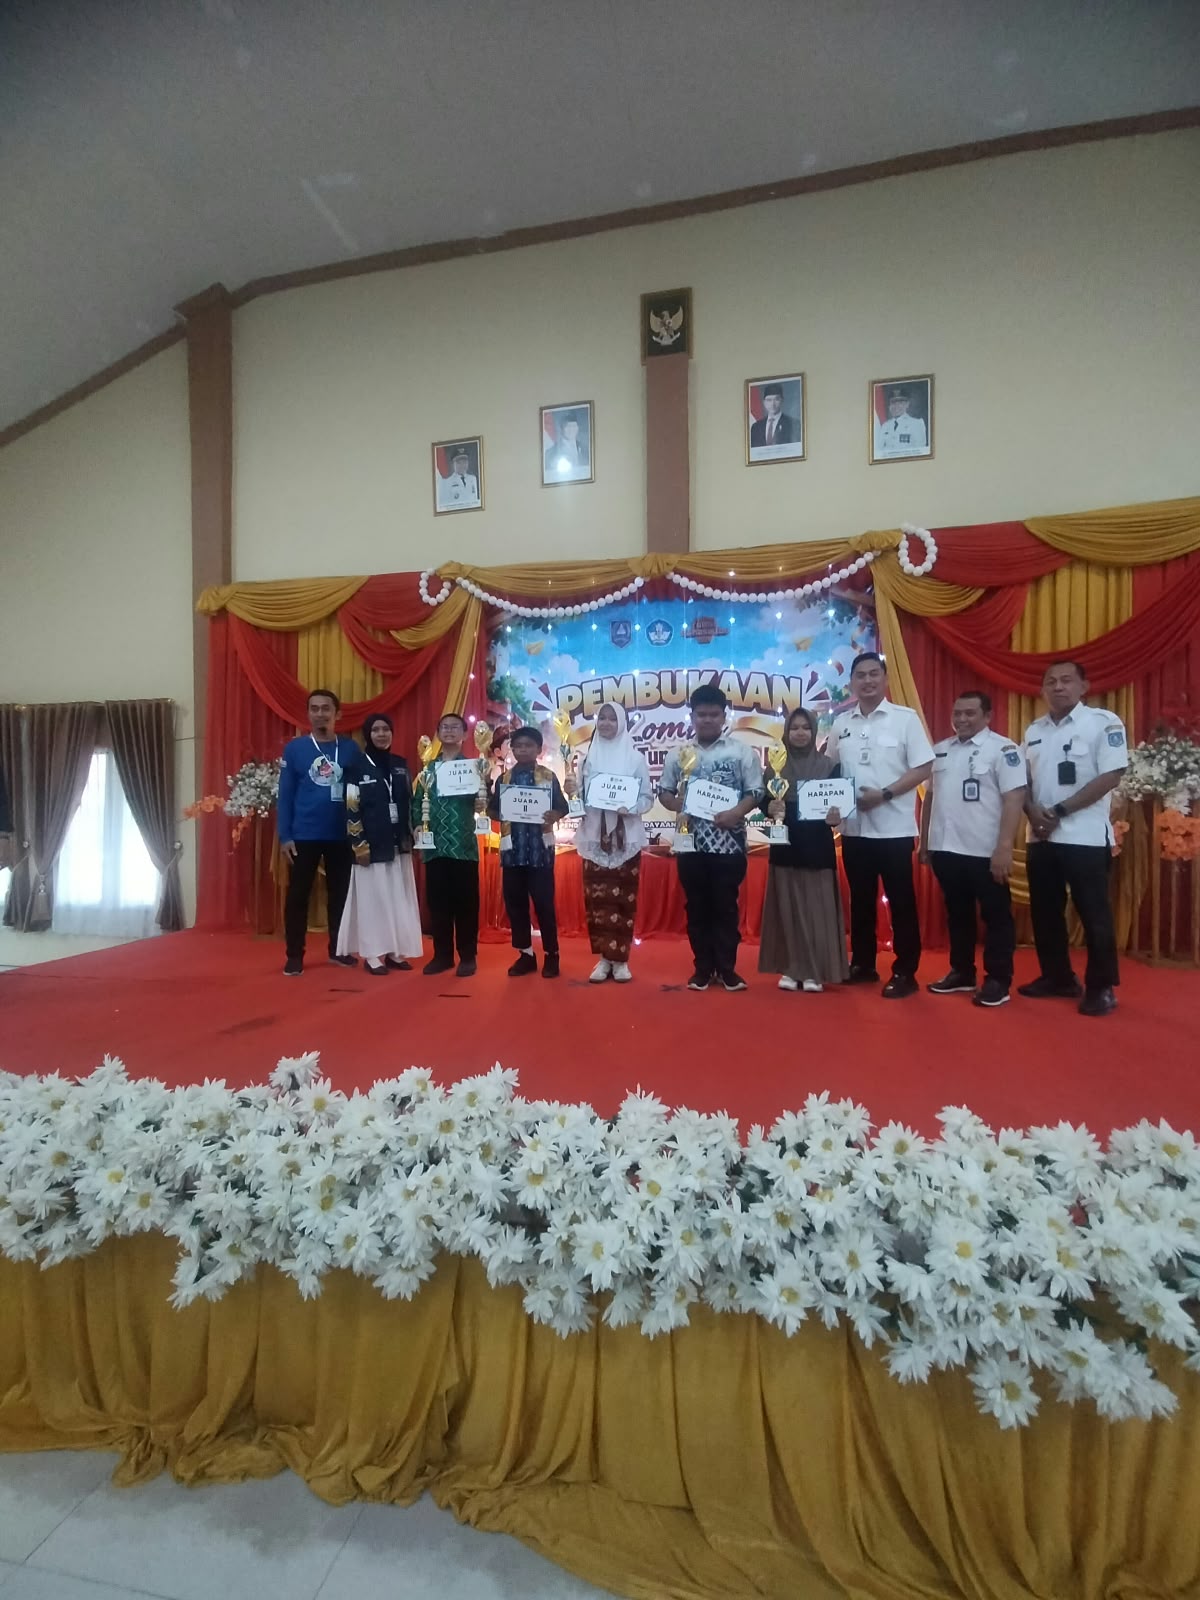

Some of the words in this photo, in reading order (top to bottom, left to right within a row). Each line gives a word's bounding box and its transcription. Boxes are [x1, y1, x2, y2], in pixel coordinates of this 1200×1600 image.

[556, 669, 803, 722] PEMBUKAAN
[601, 783, 628, 792] JUARA
[696, 789, 730, 803] HARAPAN
[808, 790, 845, 798] HARAPAN
